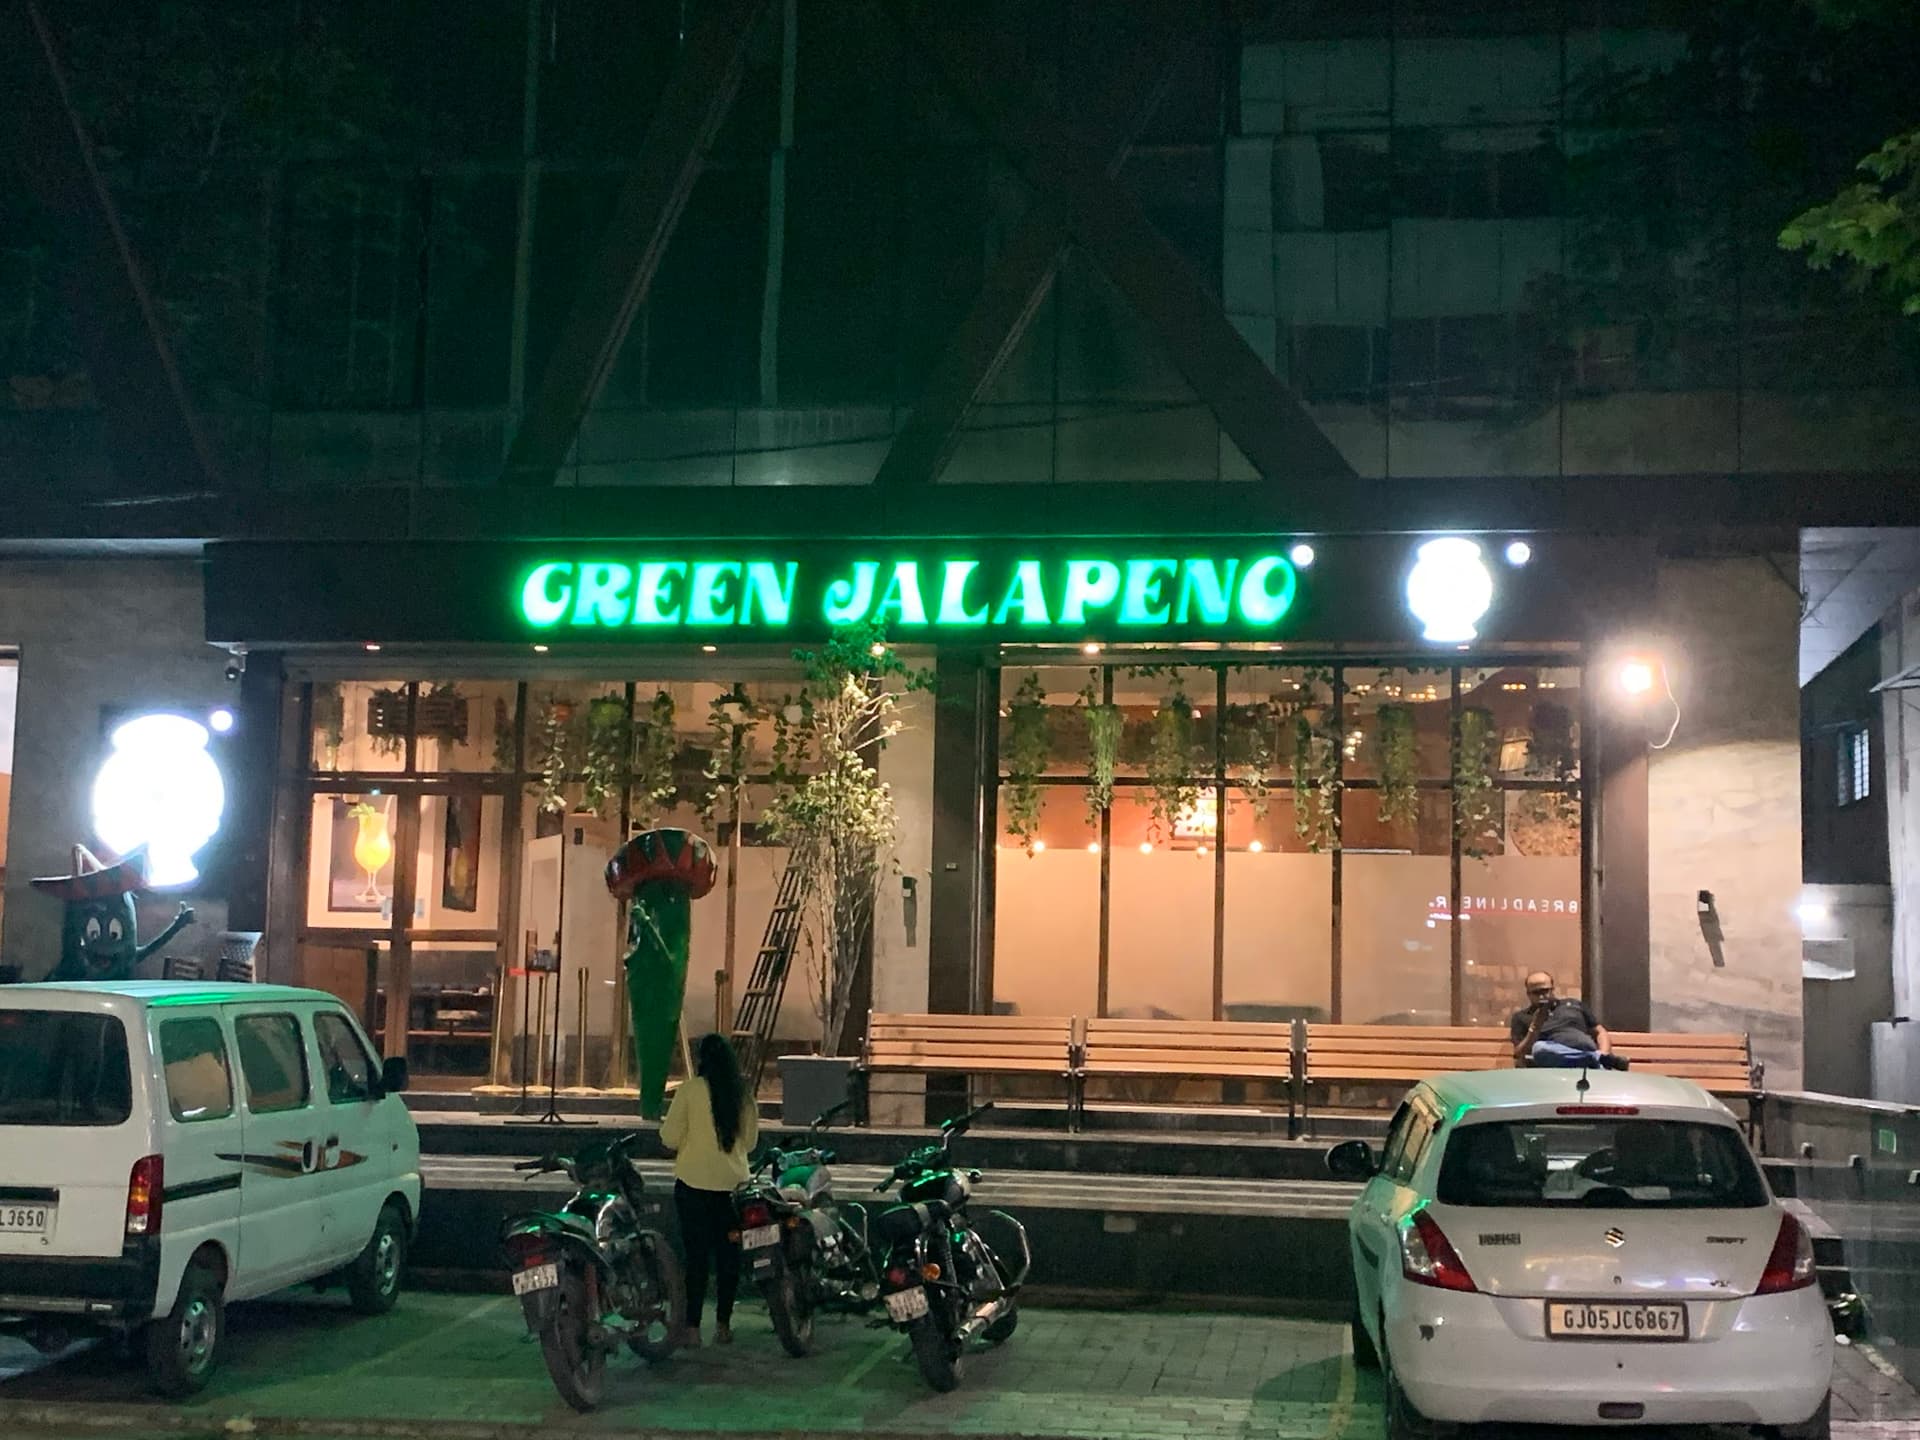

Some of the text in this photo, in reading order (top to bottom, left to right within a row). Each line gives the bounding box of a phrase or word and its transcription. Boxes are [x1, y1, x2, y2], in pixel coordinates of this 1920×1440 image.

[519, 555, 1298, 627] GREEN JALAPENO
[1564, 1309, 1680, 1331] GJ05JC6867
